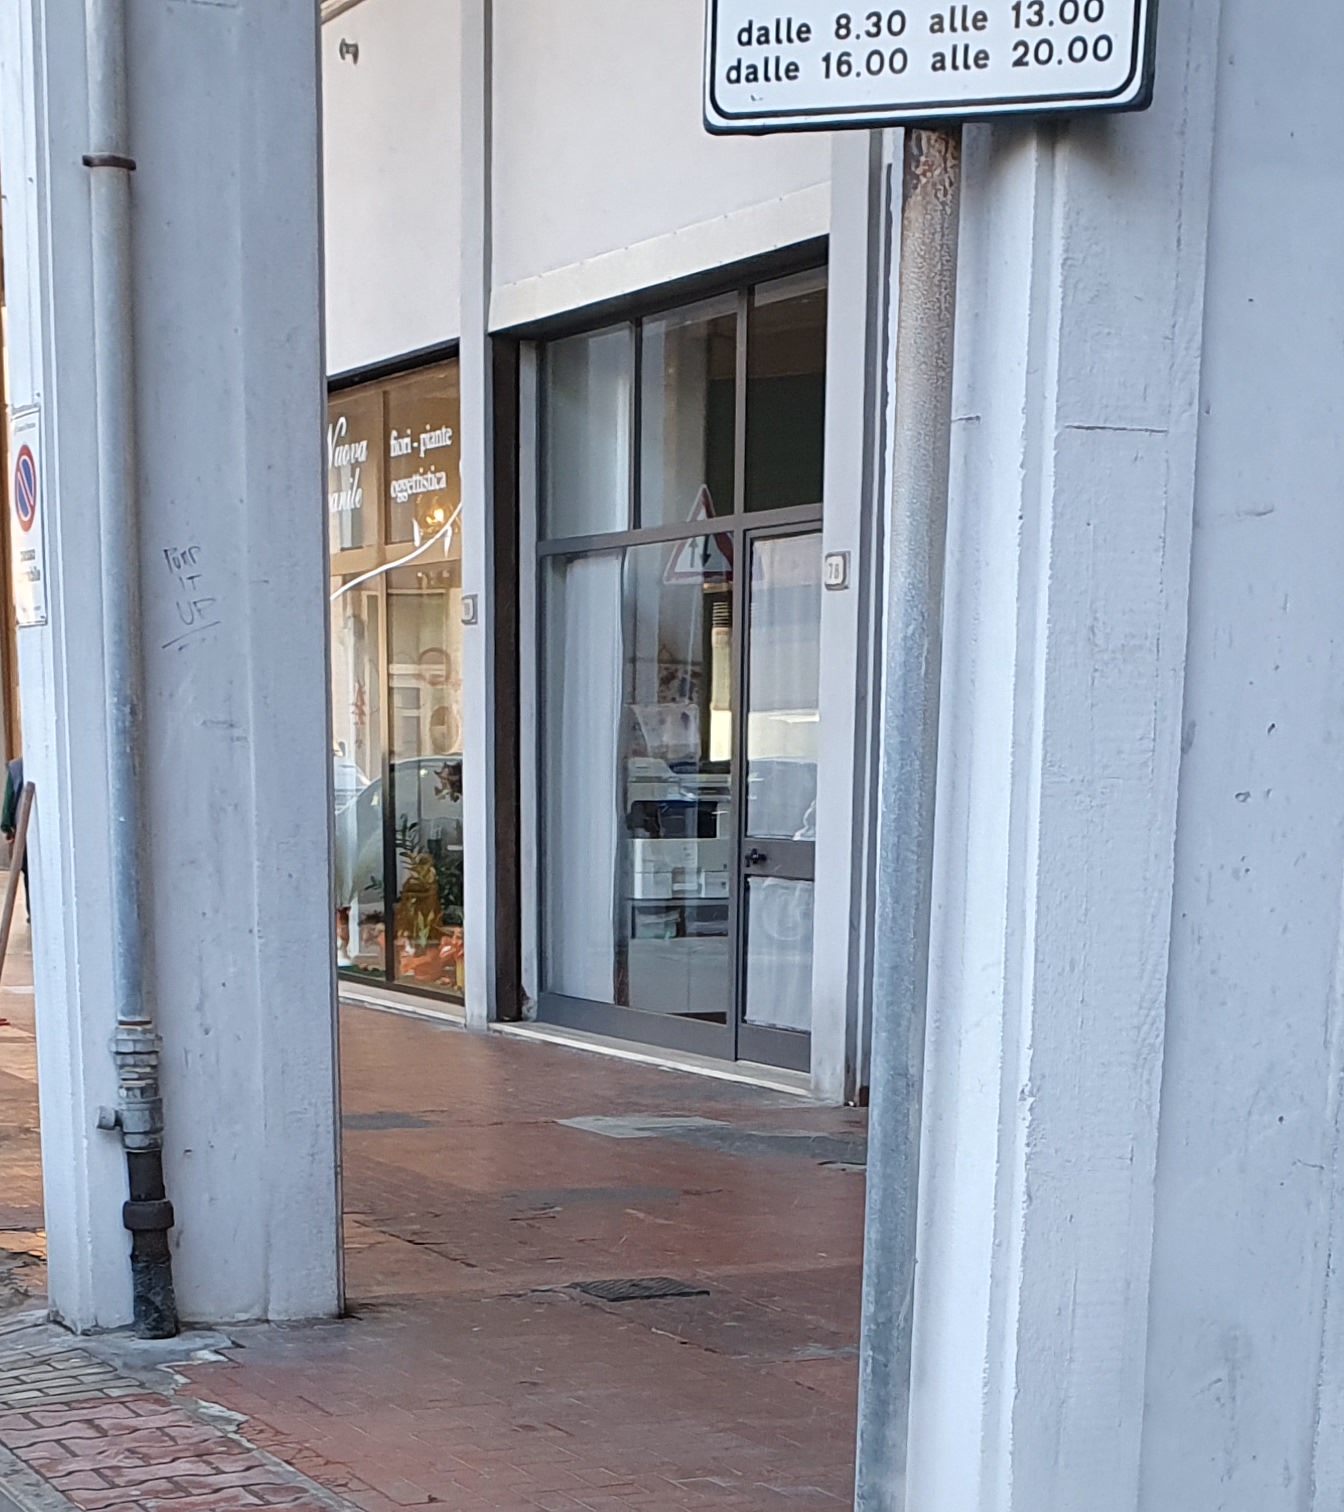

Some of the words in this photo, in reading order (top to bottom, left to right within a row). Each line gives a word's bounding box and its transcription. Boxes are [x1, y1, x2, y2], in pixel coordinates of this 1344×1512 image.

[737, 19, 812, 46] dalle
[834, 9, 907, 41] 8.30
[929, 5, 989, 34] alle
[1011, 0, 1105, 29] 13.00
[726, 57, 800, 84] dalle
[821, 48, 908, 80] 16.00
[931, 44, 990, 72] alle
[1012, 34, 1113, 67] 20.00
